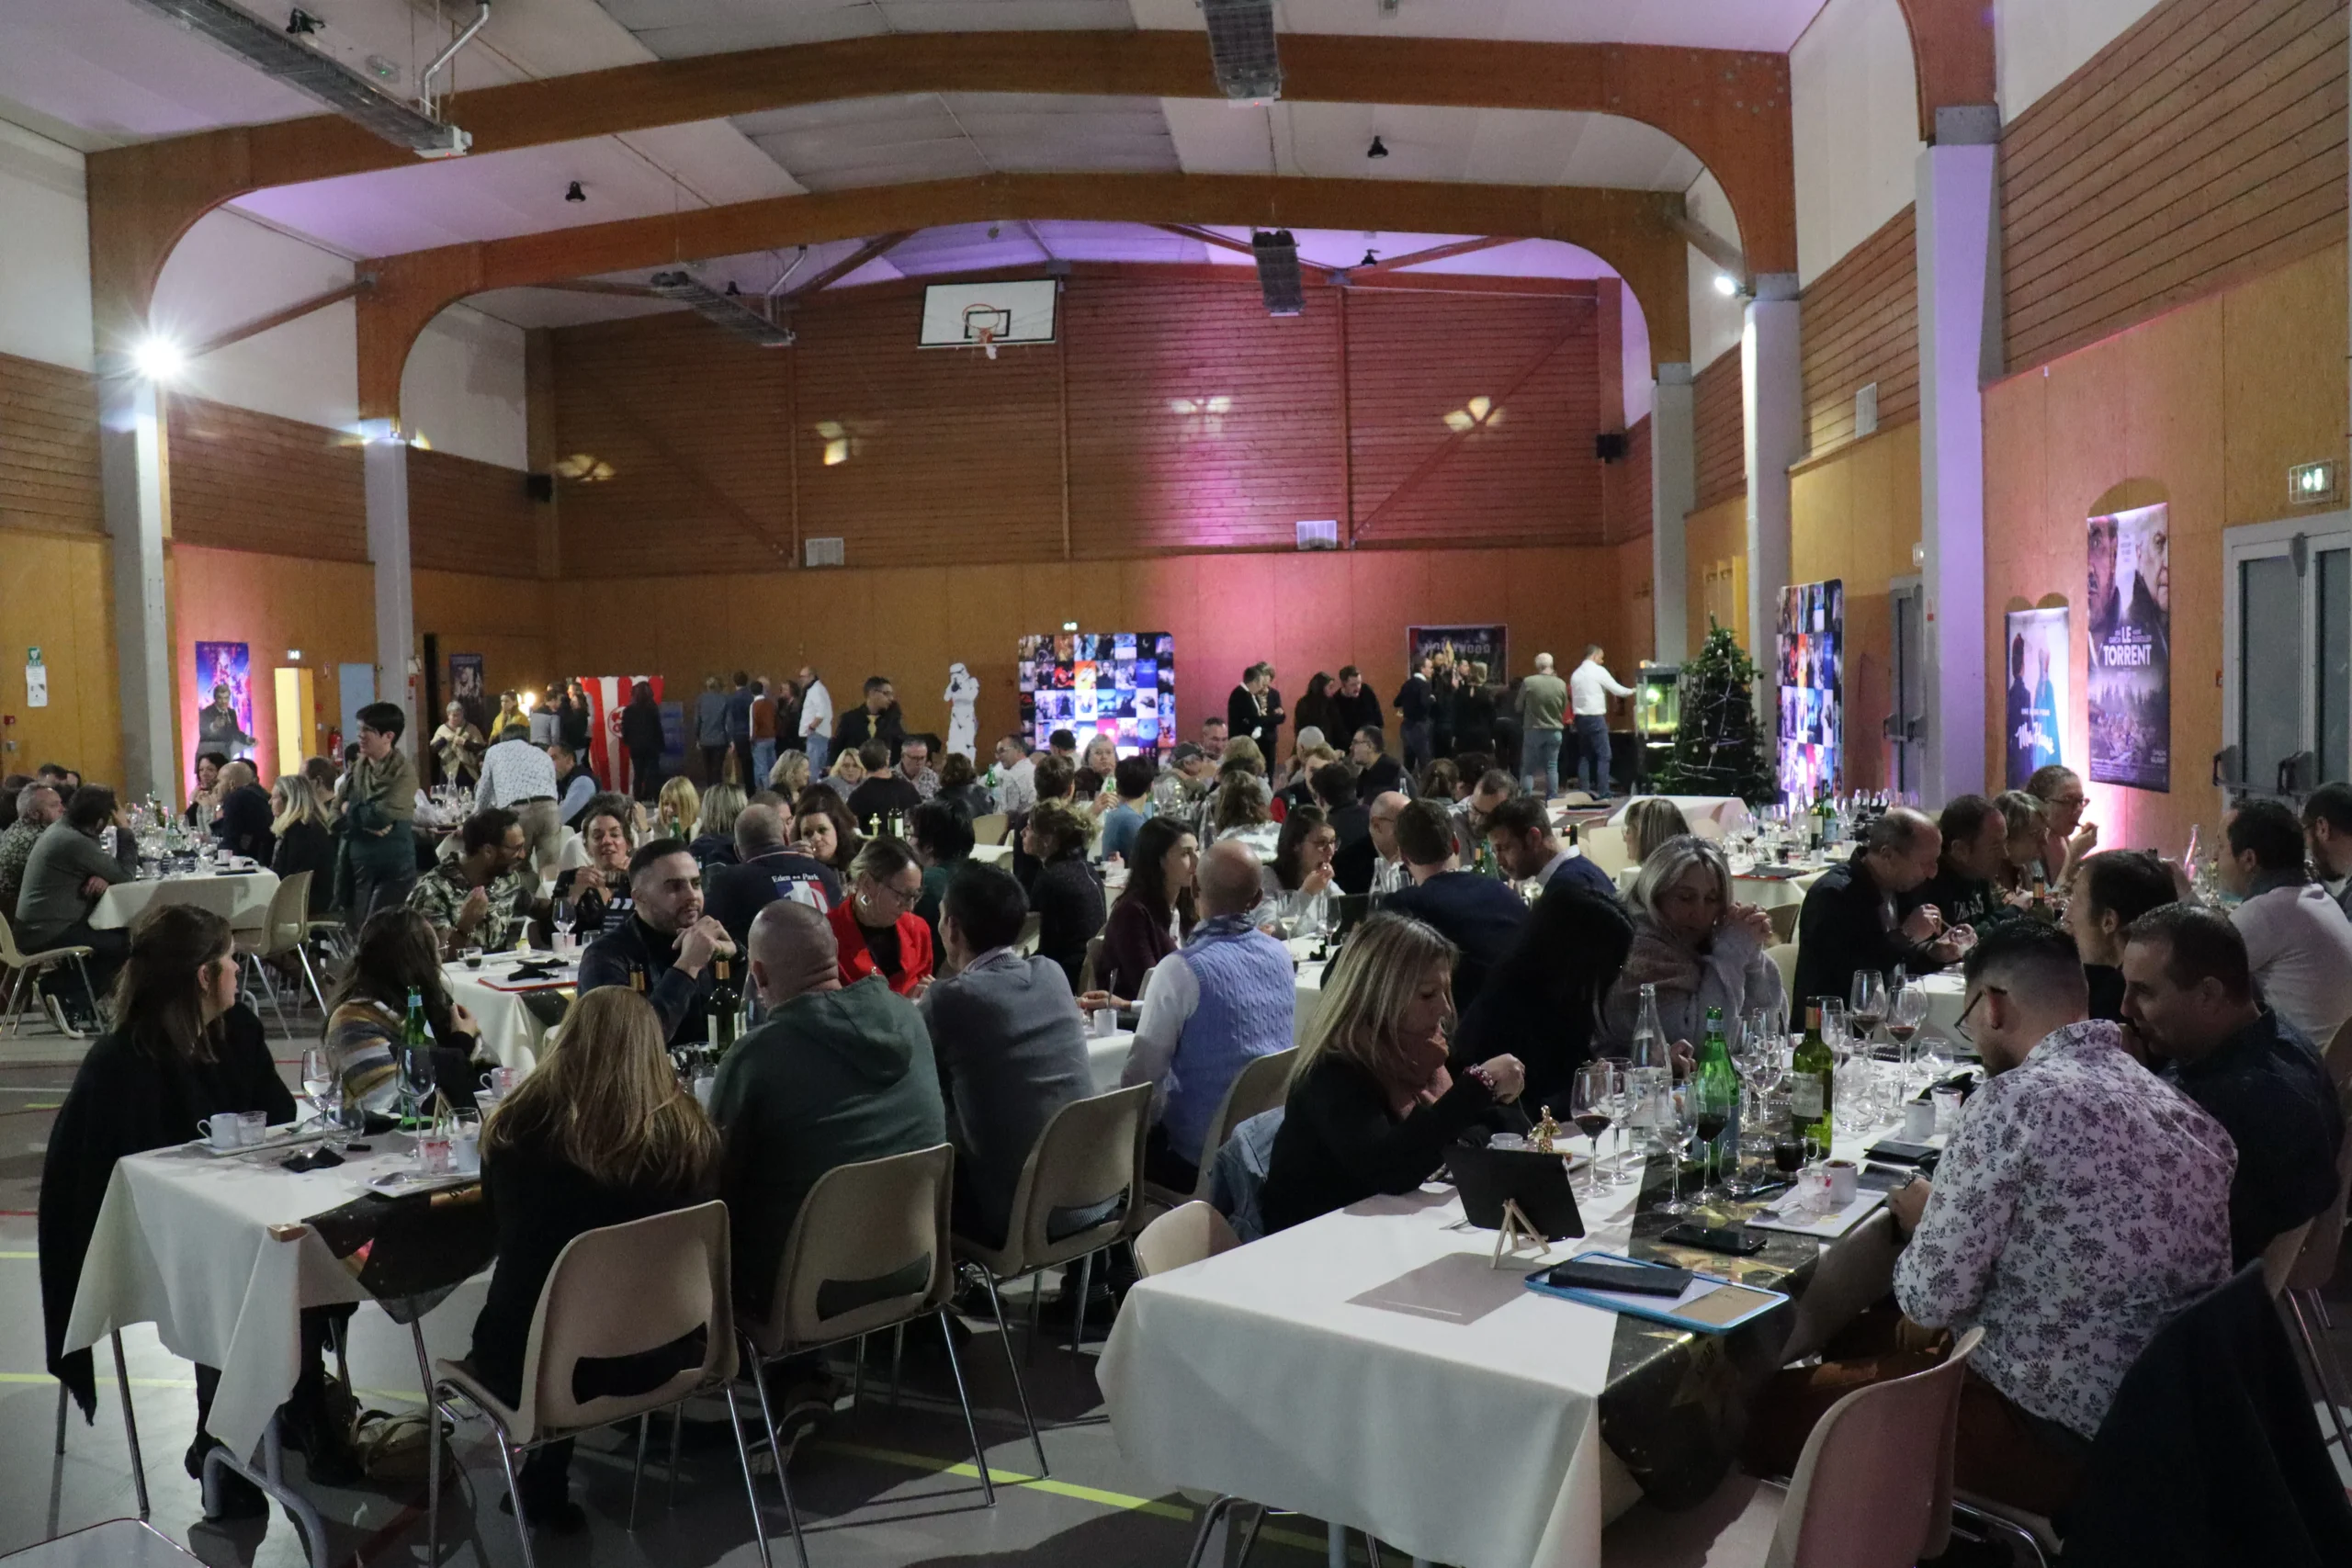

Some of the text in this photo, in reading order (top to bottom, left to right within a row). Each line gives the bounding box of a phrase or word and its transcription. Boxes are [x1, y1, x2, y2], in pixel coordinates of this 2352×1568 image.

[2121, 626, 2132, 643] LE
[2103, 644, 2152, 666] TORRENT
[772, 873, 820, 883] Eden Park
